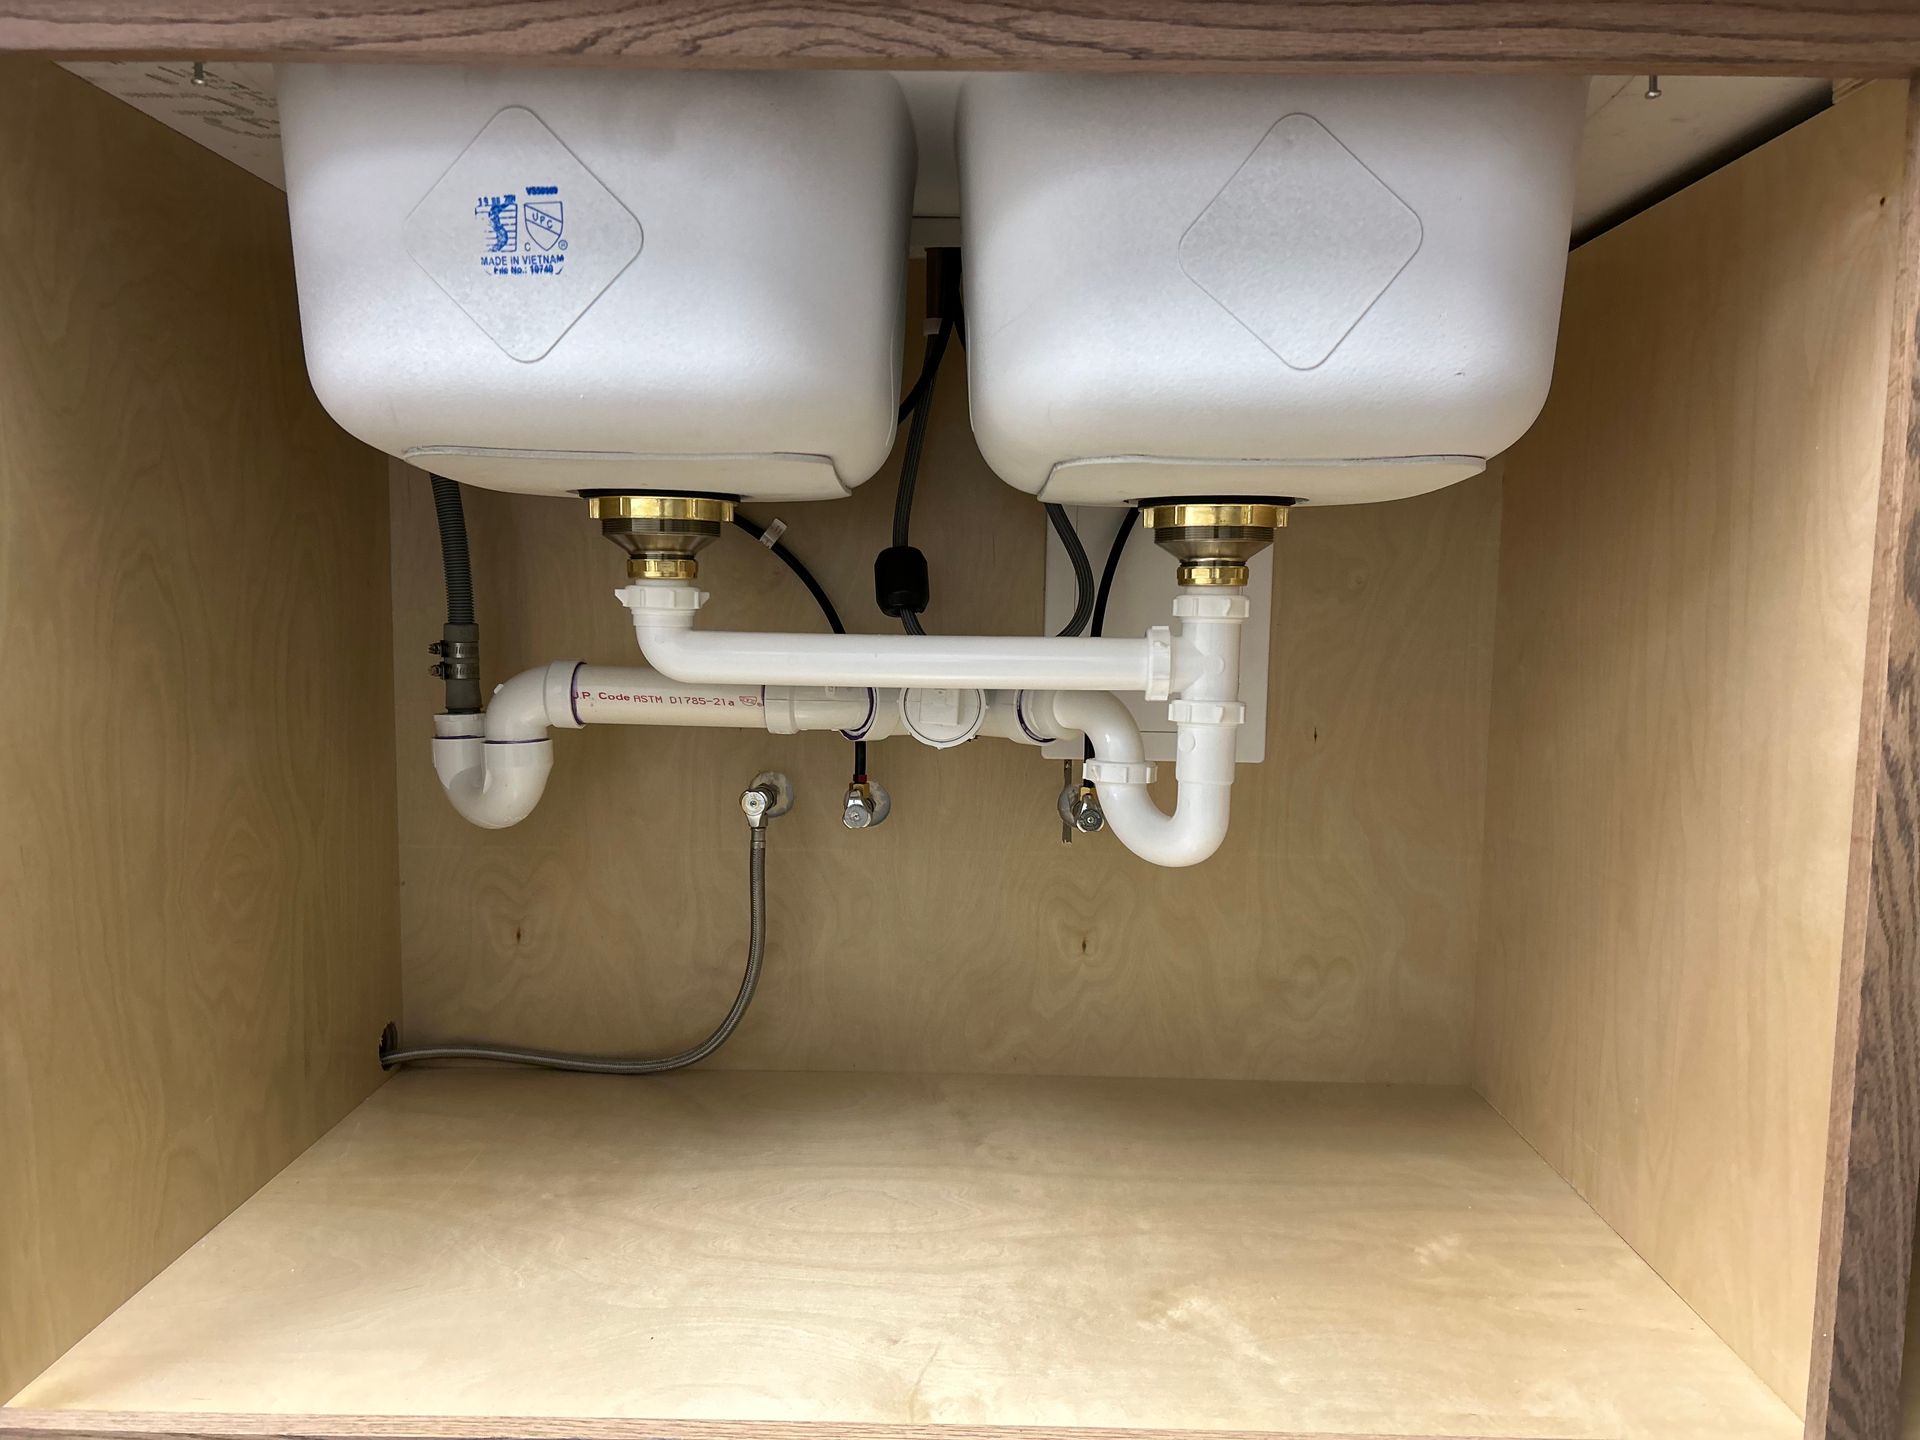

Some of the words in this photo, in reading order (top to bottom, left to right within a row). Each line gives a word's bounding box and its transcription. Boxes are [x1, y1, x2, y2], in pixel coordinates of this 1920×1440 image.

[532, 212, 553, 228] UPC
[481, 256, 507, 266] MADE
[510, 256, 520, 265] IN
[522, 254, 565, 265] VIETNAM
[598, 691, 630, 701] Code
[633, 694, 663, 704] ASTM
[669, 696, 735, 707] D1785-21a
